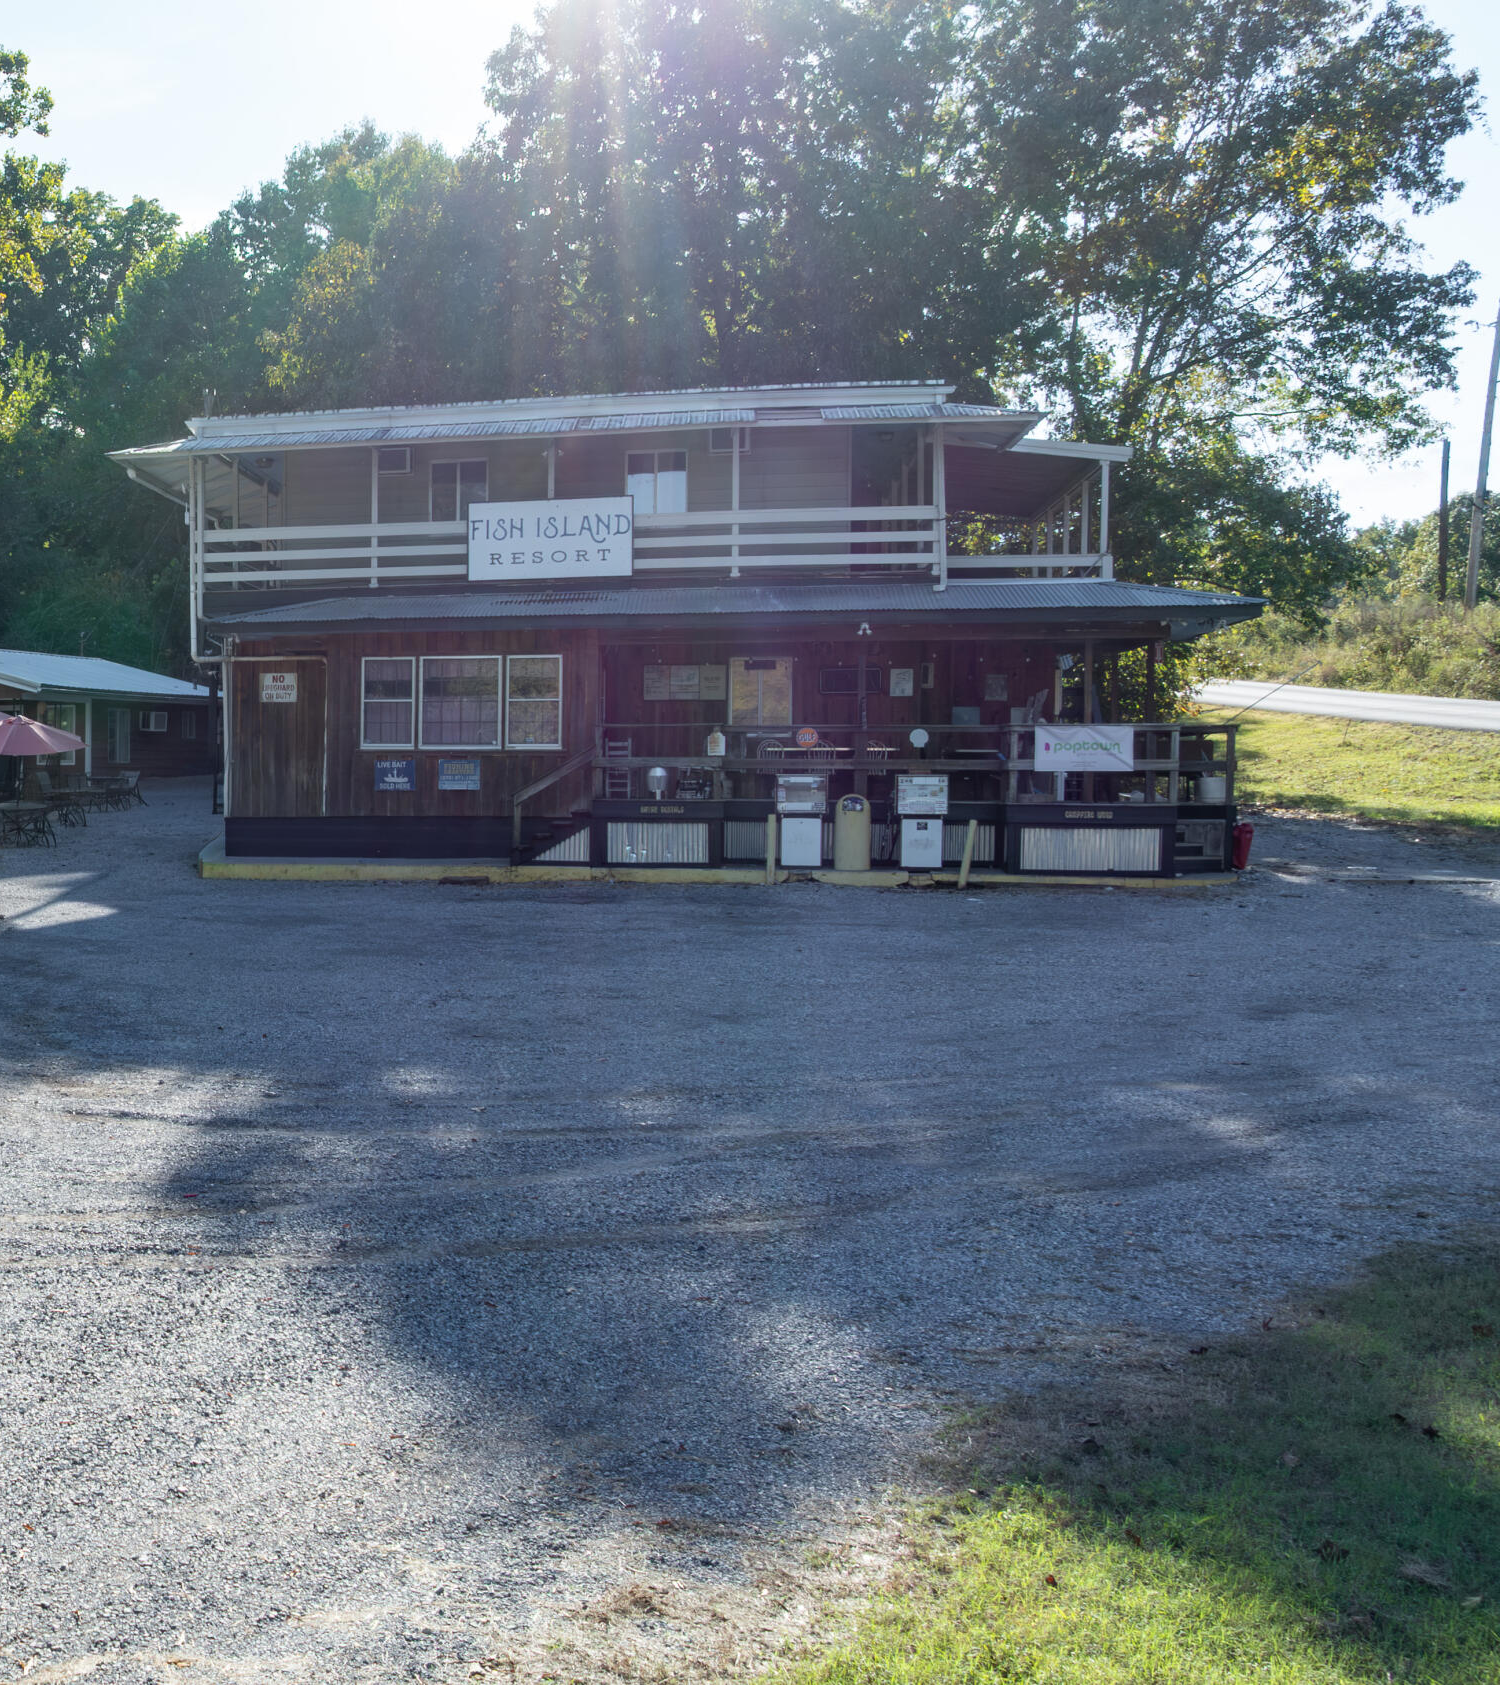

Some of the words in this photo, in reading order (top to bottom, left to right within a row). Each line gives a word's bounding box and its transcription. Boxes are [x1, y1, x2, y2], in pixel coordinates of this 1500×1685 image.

[470, 518, 524, 541] FISH
[536, 513, 631, 544] ISLAND
[489, 548, 611, 566] RESORT
[272, 675, 285, 683] NO
[265, 692, 274, 700] ON
[276, 692, 292, 700] DUTY
[1054, 741, 1123, 754] poptown
